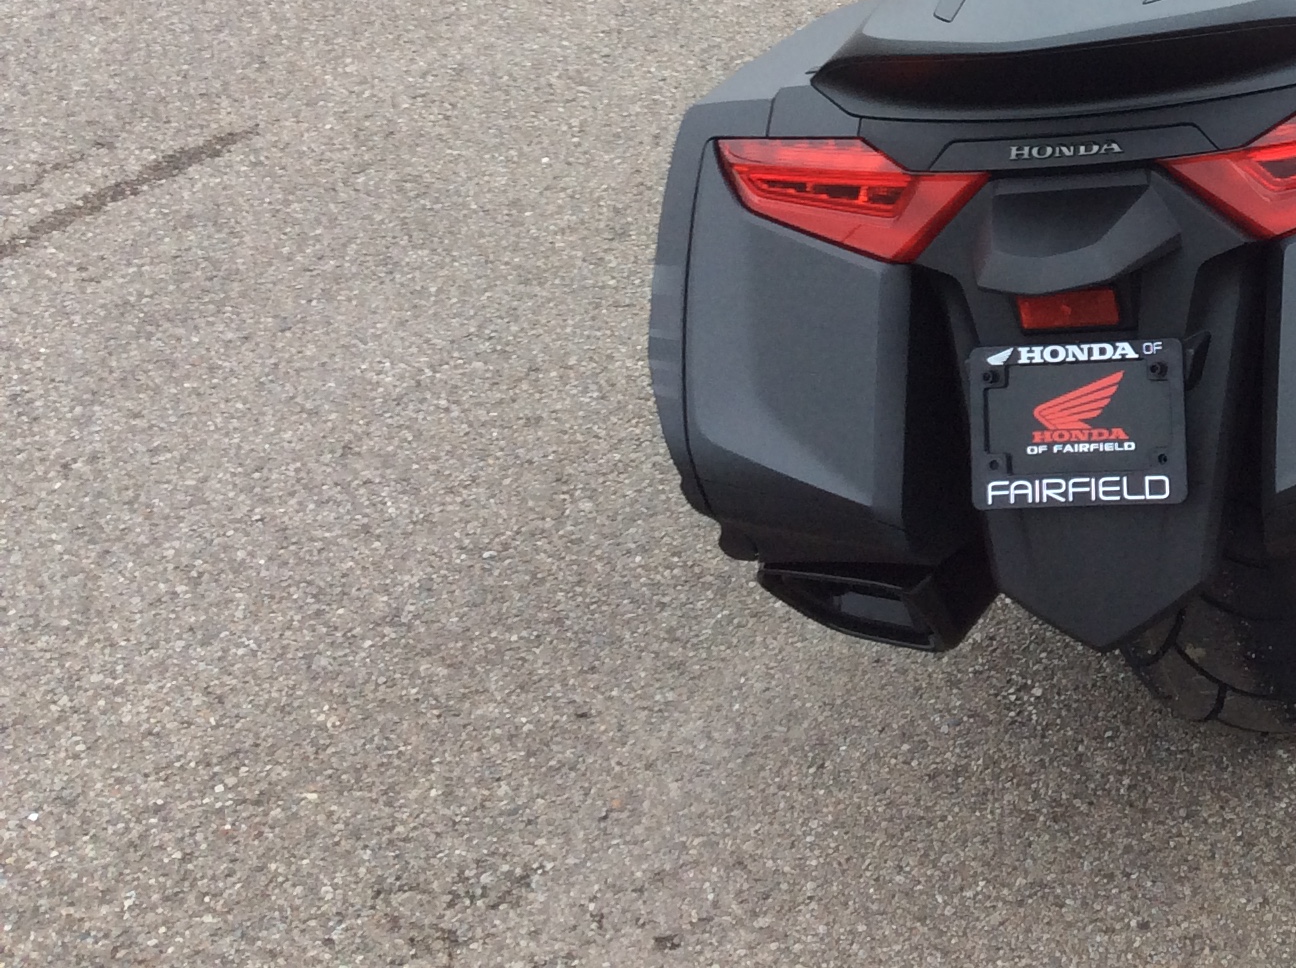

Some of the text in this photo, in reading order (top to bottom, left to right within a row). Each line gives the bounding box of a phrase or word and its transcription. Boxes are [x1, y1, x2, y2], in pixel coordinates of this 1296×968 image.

[1009, 142, 1124, 160] HONDA
[1017, 342, 1162, 364] HONDA OF
[1032, 428, 1129, 443] HONDA
[1026, 441, 1136, 455] OF FAIRFIELD
[987, 475, 1170, 505] FAIRFIELD
